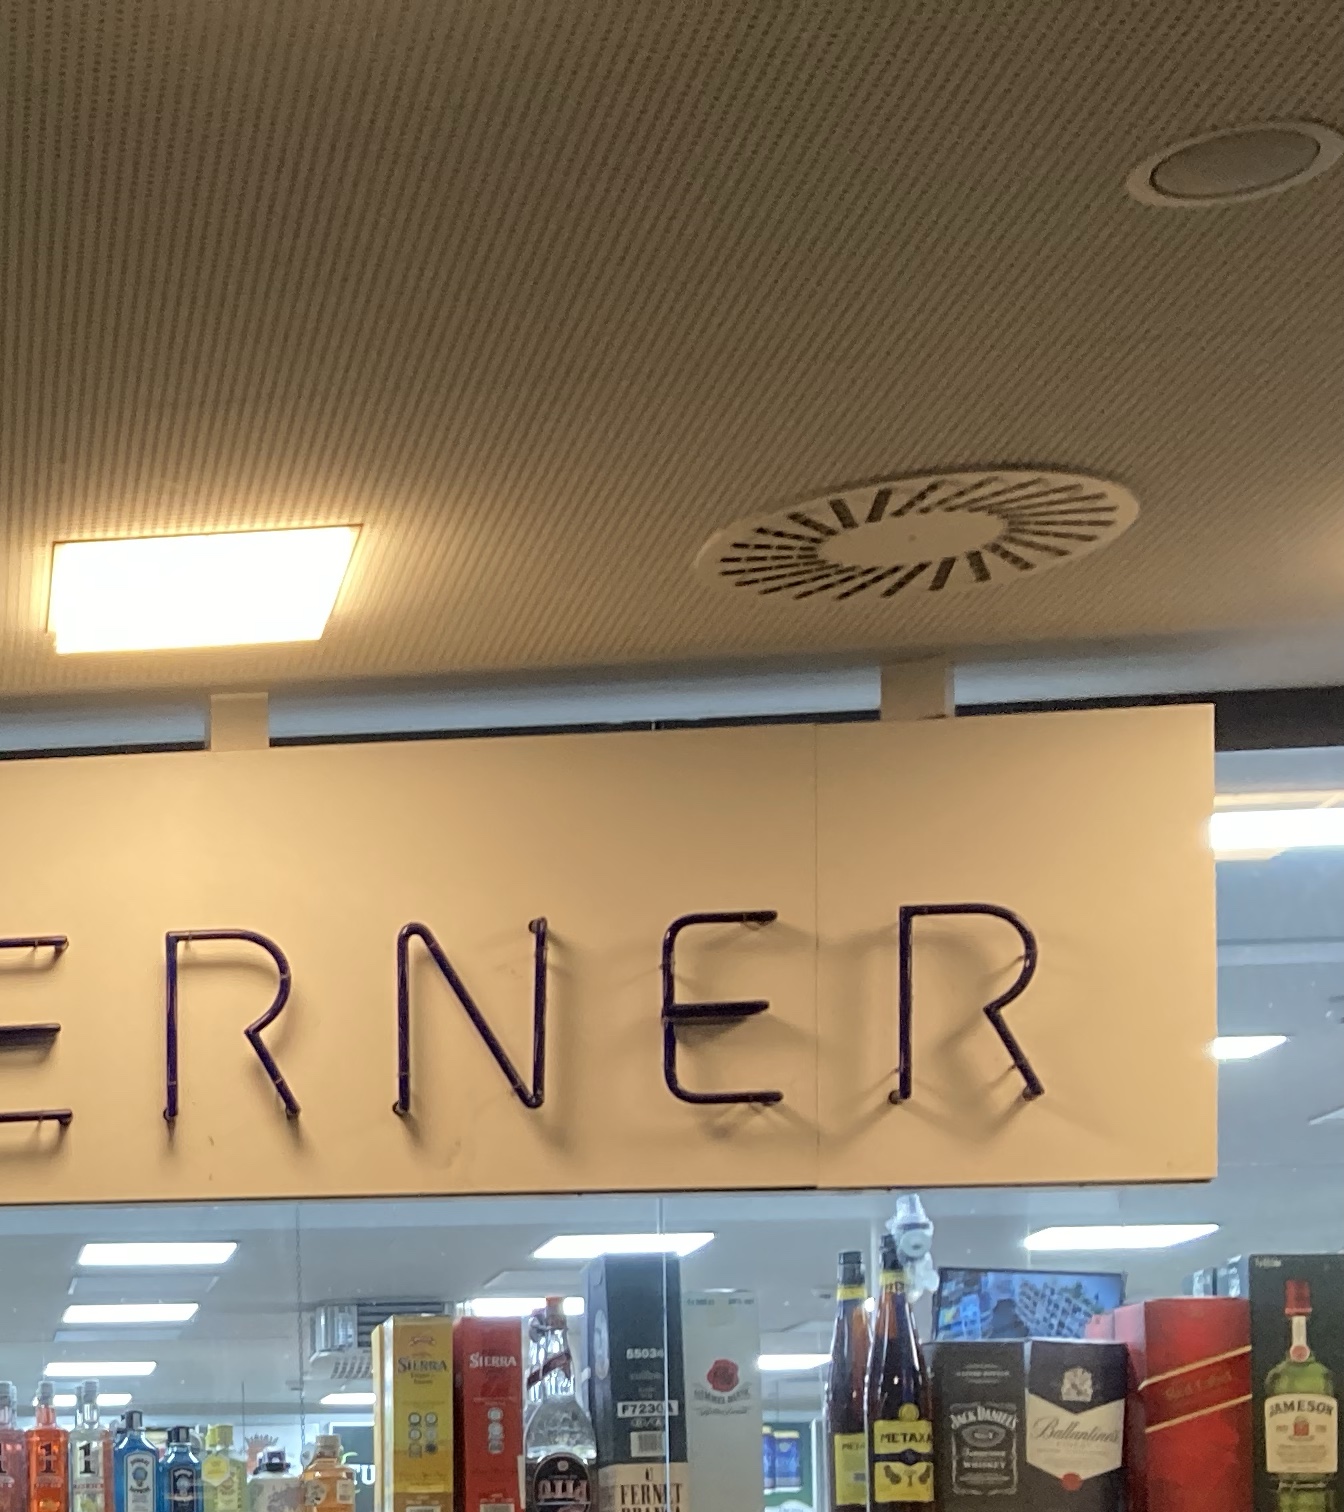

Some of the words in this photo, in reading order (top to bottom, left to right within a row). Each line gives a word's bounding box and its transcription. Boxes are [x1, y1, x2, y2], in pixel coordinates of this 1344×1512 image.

[398, 1355, 447, 1373] SIERRA
[469, 1351, 517, 1368] SIERRA
[1269, 1399, 1334, 1417] JAMESON
[841, 1442, 866, 1451] META
[39, 1442, 57, 1475] 1
[78, 1443, 96, 1475] 1
